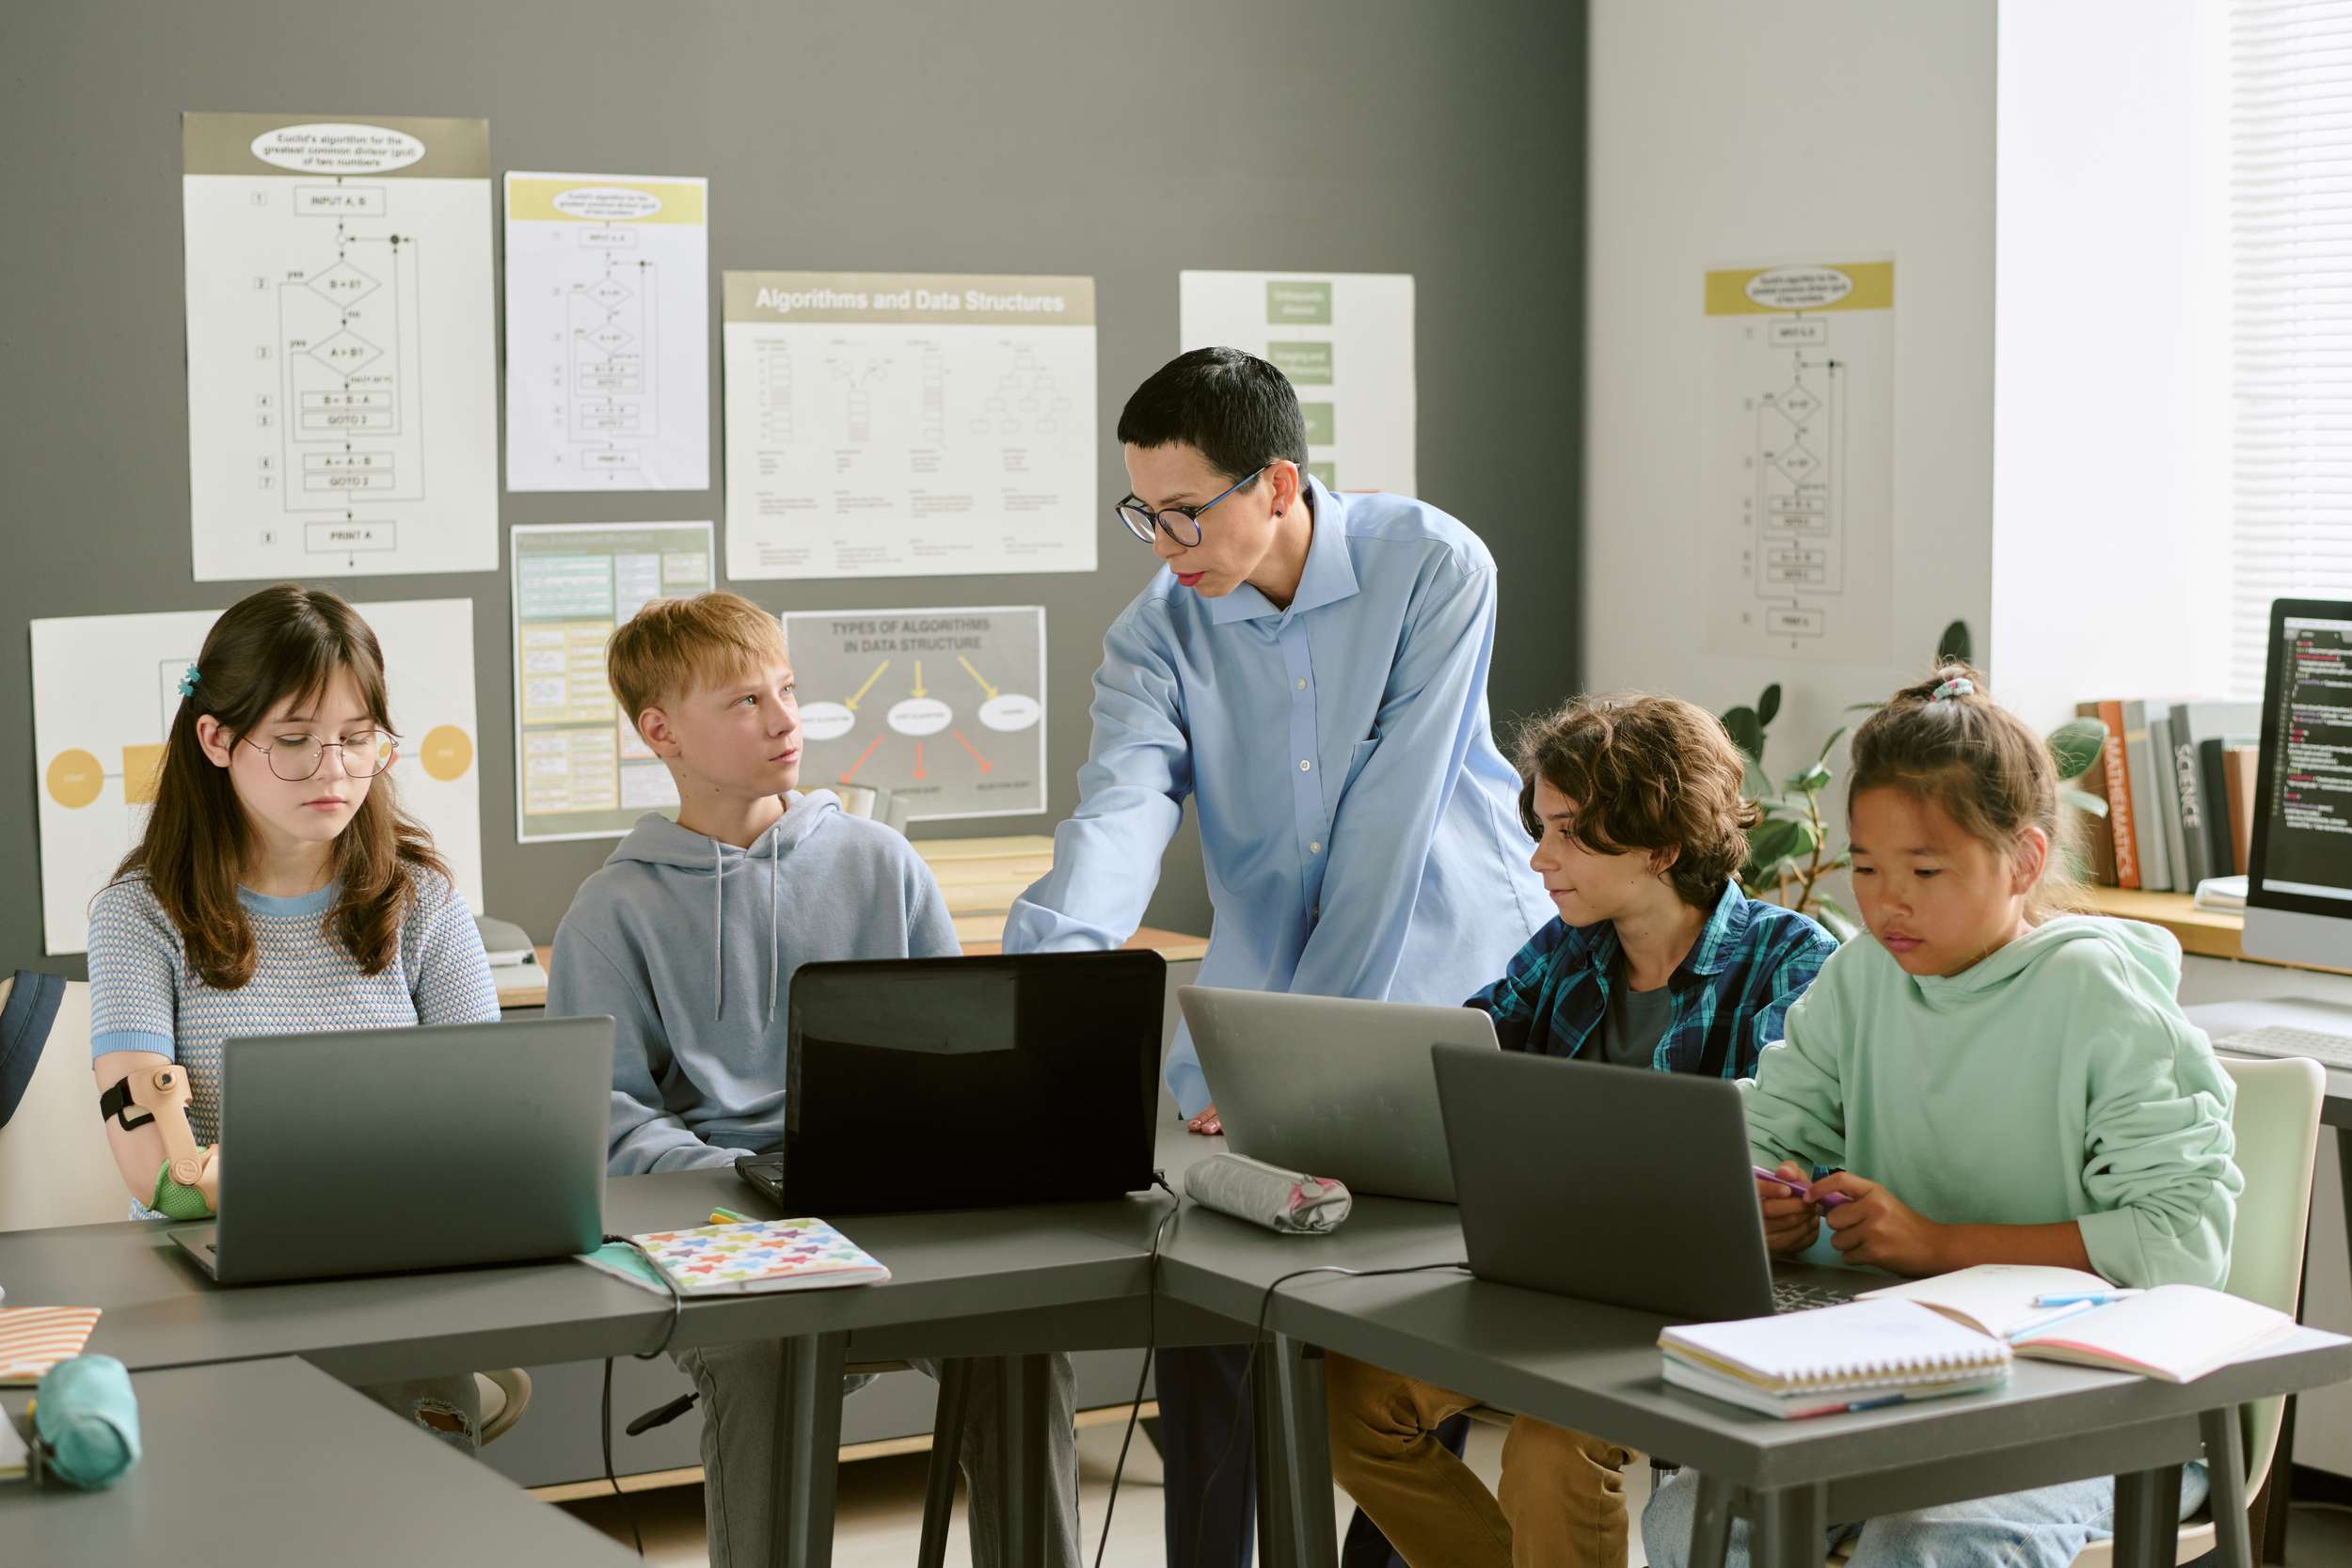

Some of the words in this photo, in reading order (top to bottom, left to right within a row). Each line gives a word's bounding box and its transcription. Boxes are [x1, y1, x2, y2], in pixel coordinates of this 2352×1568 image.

[278, 134, 317, 145] Euclid's
[321, 135, 368, 146] algorithm
[372, 135, 384, 145] for
[387, 135, 402, 145] the
[264, 147, 305, 157] greatest
[309, 147, 352, 156] common
[355, 146, 388, 156] divisor
[304, 157, 313, 166] of
[315, 156, 332, 166] two
[338, 158, 381, 167] numbers
[310, 196, 342, 206] INPUT
[345, 196, 356, 207] A,
[287, 270, 304, 280] yes
[755, 287, 868, 313] Algorithms
[872, 289, 912, 309] and
[915, 289, 960, 310] Data
[964, 289, 1065, 312] Structures
[289, 339, 307, 348] yes
[330, 348, 339, 357] A
[327, 415, 359, 424] GOTO
[329, 477, 360, 486] GOTO
[330, 531, 361, 541] PRINT
[364, 531, 373, 540] A
[832, 621, 876, 635] TYPES
[879, 620, 898, 634] OF
[901, 618, 990, 633] ALGORITHMS
[844, 641, 858, 653] IN
[861, 640, 897, 652] DATA
[900, 636, 981, 651] STRUCTURE
[2174, 744, 2201, 829] SCIENCE
[2106, 737, 2132, 879] MATHEMATICS
